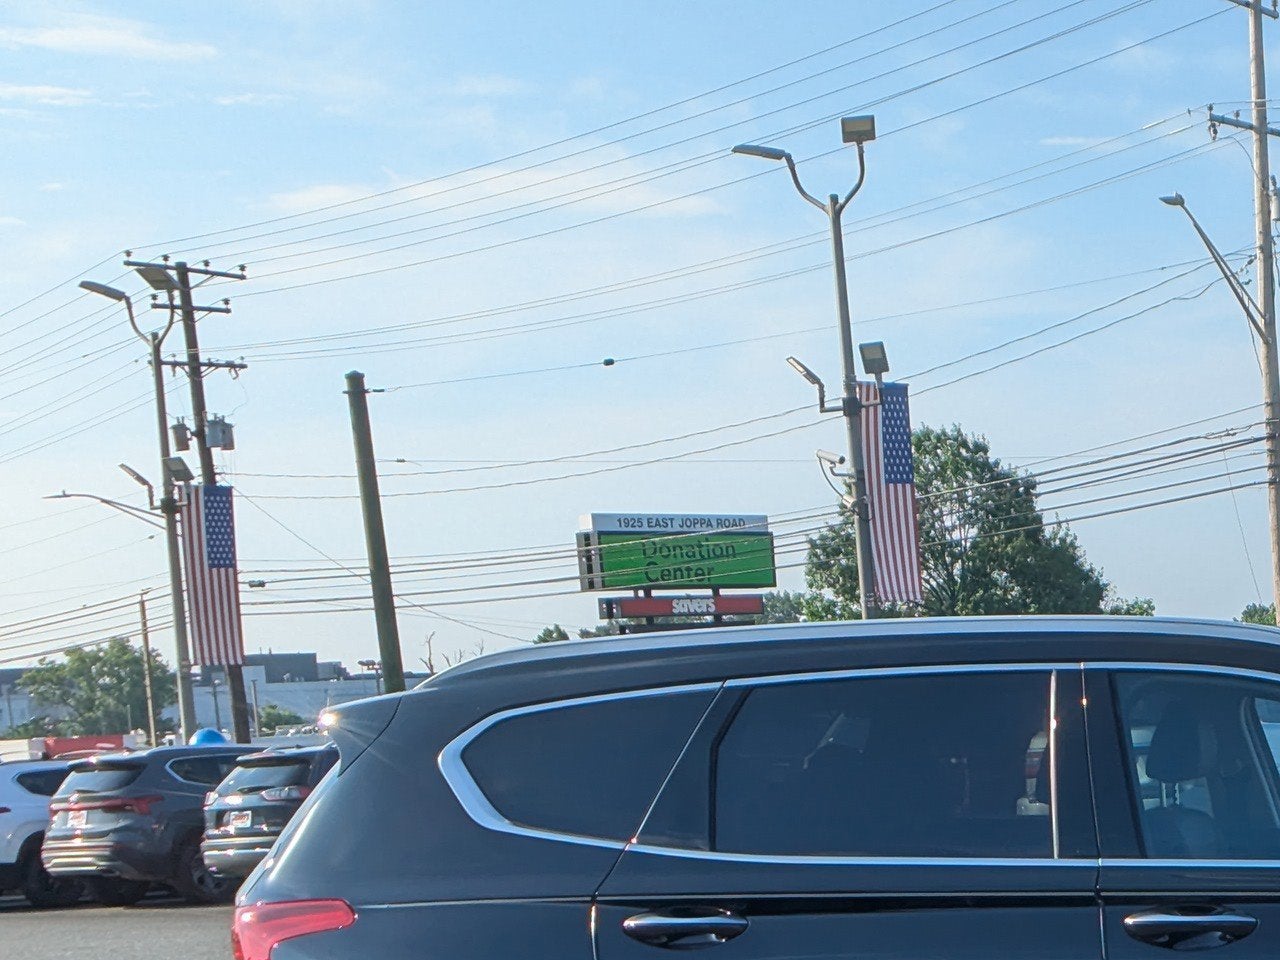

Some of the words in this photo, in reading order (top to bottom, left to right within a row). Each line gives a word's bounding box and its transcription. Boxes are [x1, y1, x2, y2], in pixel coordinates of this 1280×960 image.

[616, 517, 644, 528] 1925
[647, 517, 675, 528] EAST
[678, 517, 713, 529] JOPPA
[716, 518, 746, 529] ROAD
[641, 538, 737, 560] Donation
[644, 560, 715, 583] Center
